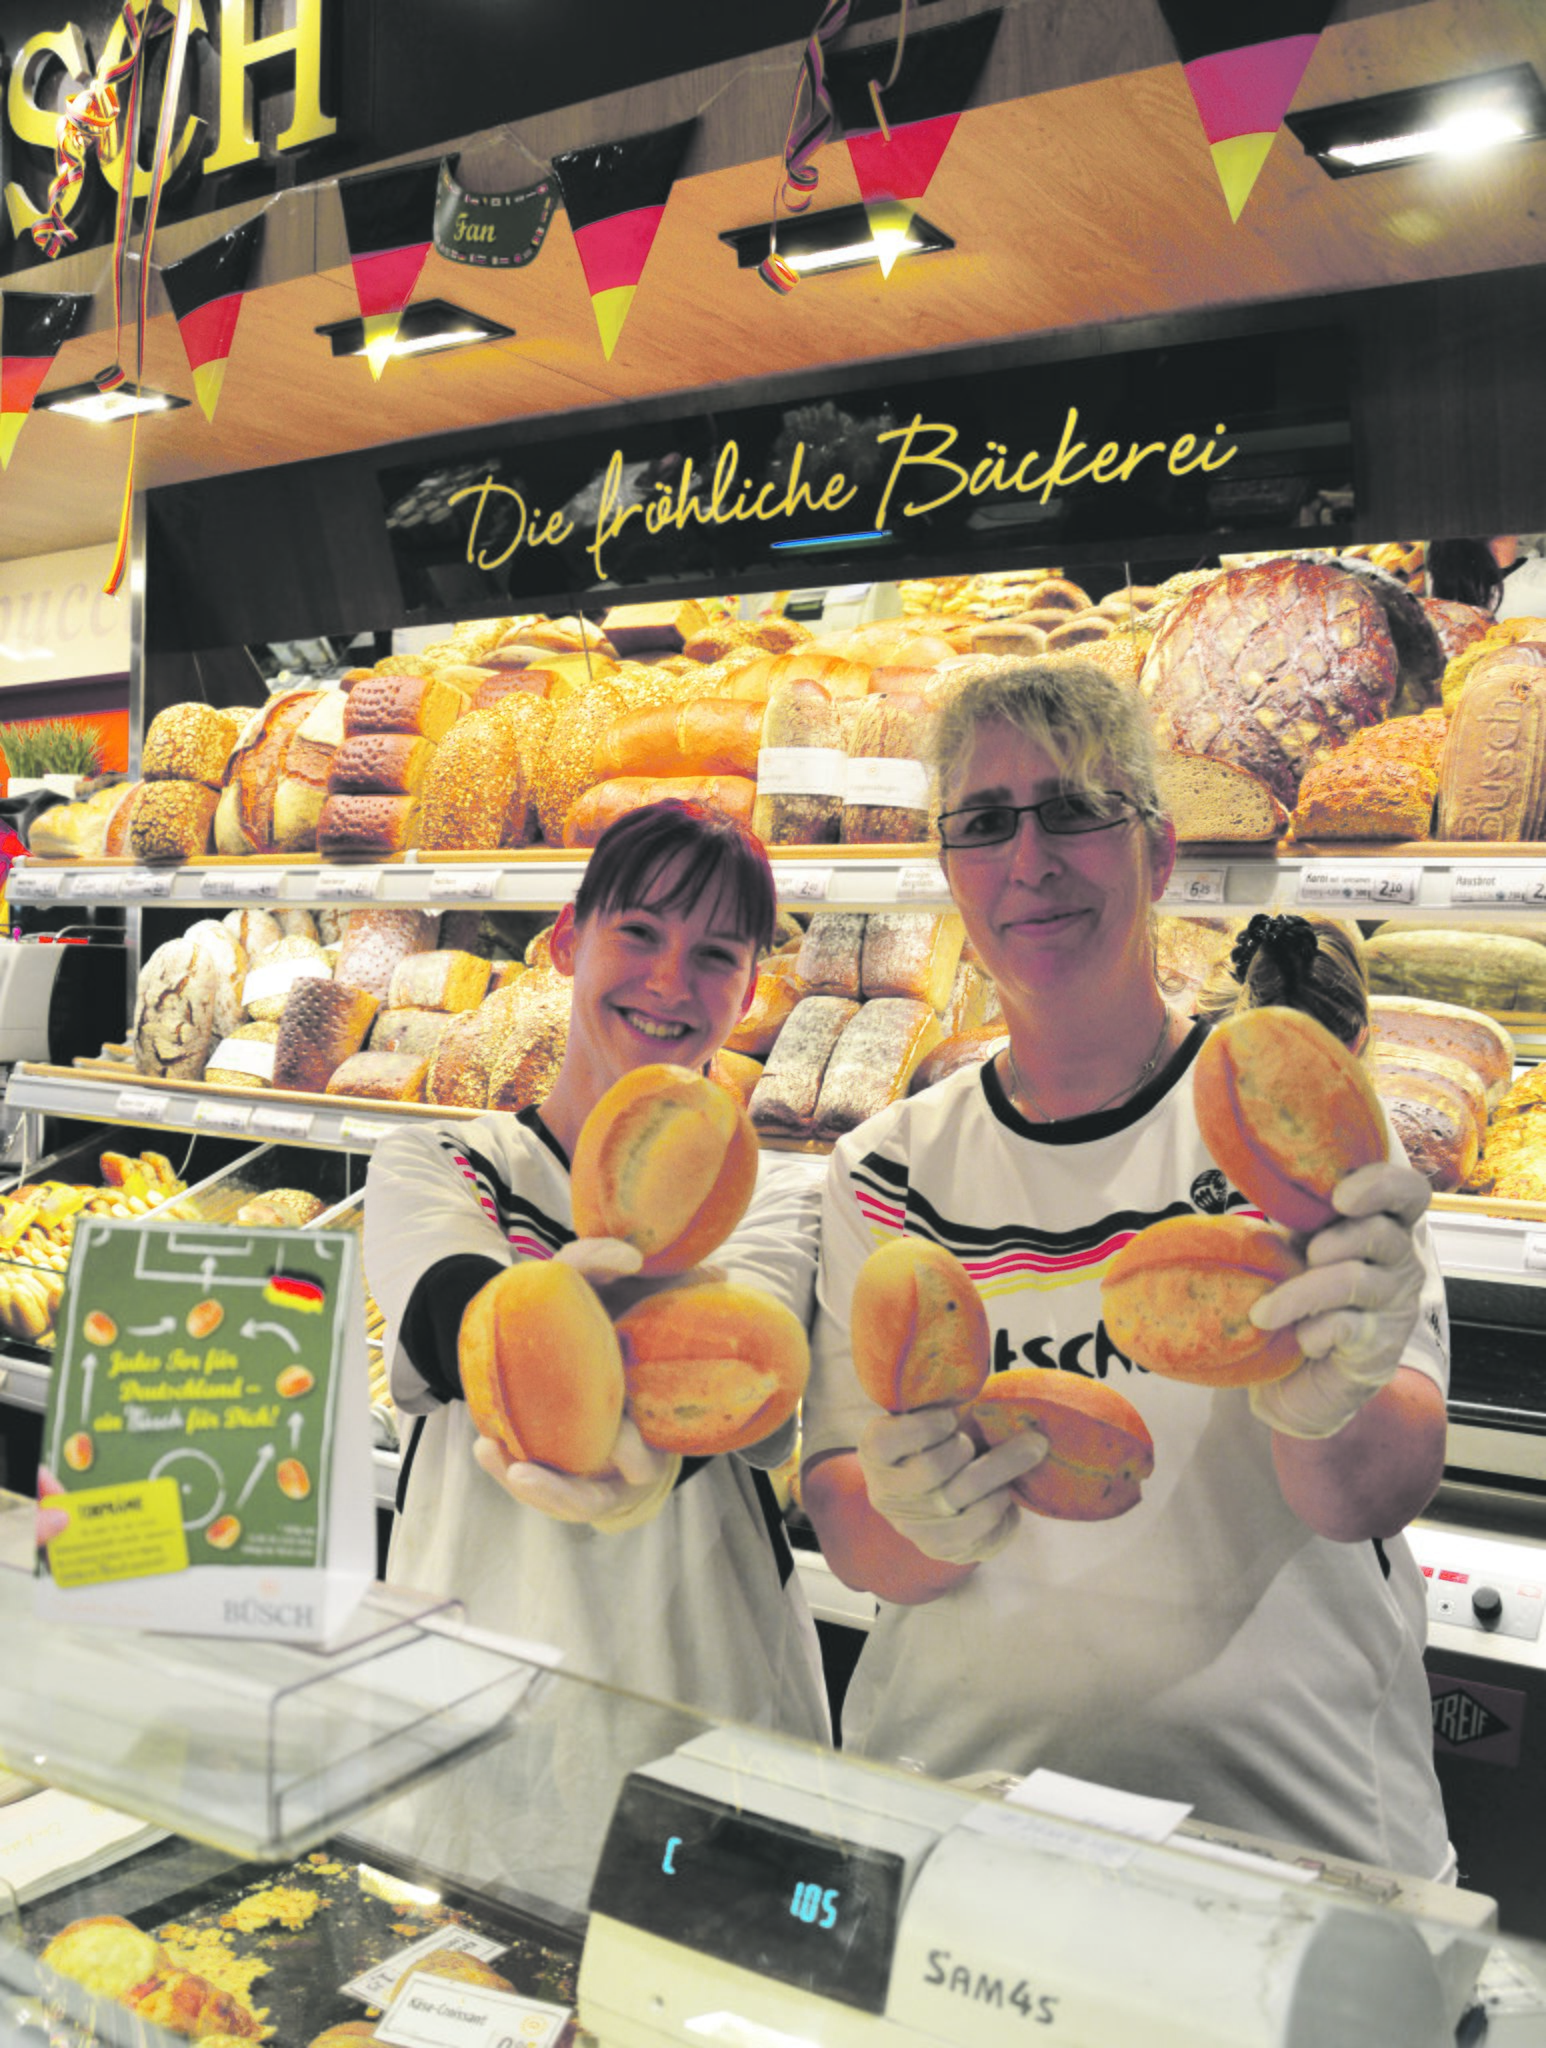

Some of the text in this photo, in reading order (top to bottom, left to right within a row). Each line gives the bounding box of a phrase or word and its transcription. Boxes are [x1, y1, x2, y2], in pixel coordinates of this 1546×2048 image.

[453, 212, 496, 243] Fan
[448, 407, 1238, 580] Die fröhliche Bäckerei
[118, 1376, 244, 1402] Deutschland
[223, 1597, 313, 1628] BÜSCH
